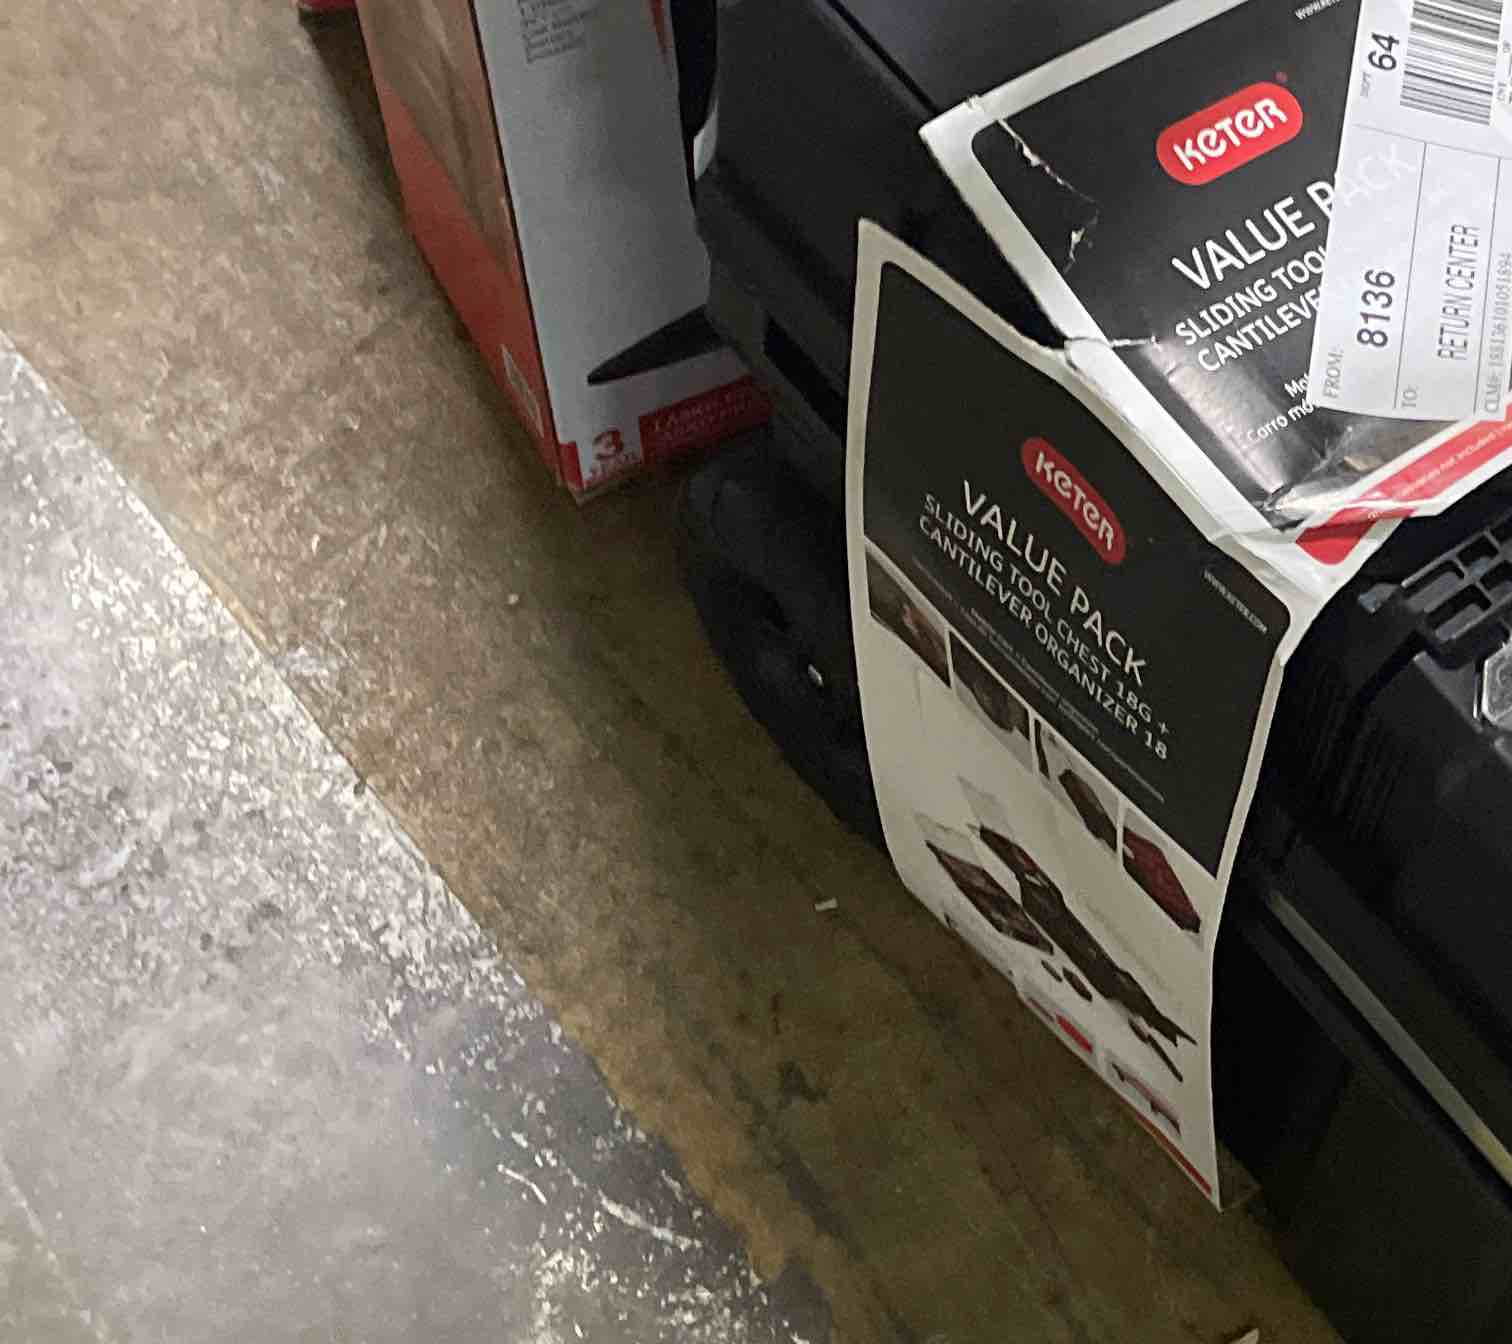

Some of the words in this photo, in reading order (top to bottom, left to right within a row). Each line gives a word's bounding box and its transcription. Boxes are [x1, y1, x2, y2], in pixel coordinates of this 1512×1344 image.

[1368, 32, 1400, 71] 64
[1173, 98, 1288, 171] KETER
[1171, 196, 1316, 289] VALUE
[1445, 224, 1480, 293] CENTER
[1176, 279, 1277, 345] SLIDING
[1198, 288, 1320, 371] CANTILEVE
[1357, 269, 1395, 348] 8136
[1438, 294, 1473, 361] RETURN
[1036, 452, 1113, 550] KETER
[926, 494, 1003, 571] SLIDING
[1009, 562, 1052, 624] TOOL
[1057, 619, 1110, 681] CHEST
[1116, 680, 1151, 723] 18G
[964, 480, 1067, 597] VALUE
[1070, 585, 1146, 687] PACK
[920, 516, 1032, 629] CANTILEVER
[1035, 623, 1138, 735] ORGANIZER
[1145, 731, 1168, 760] 18
